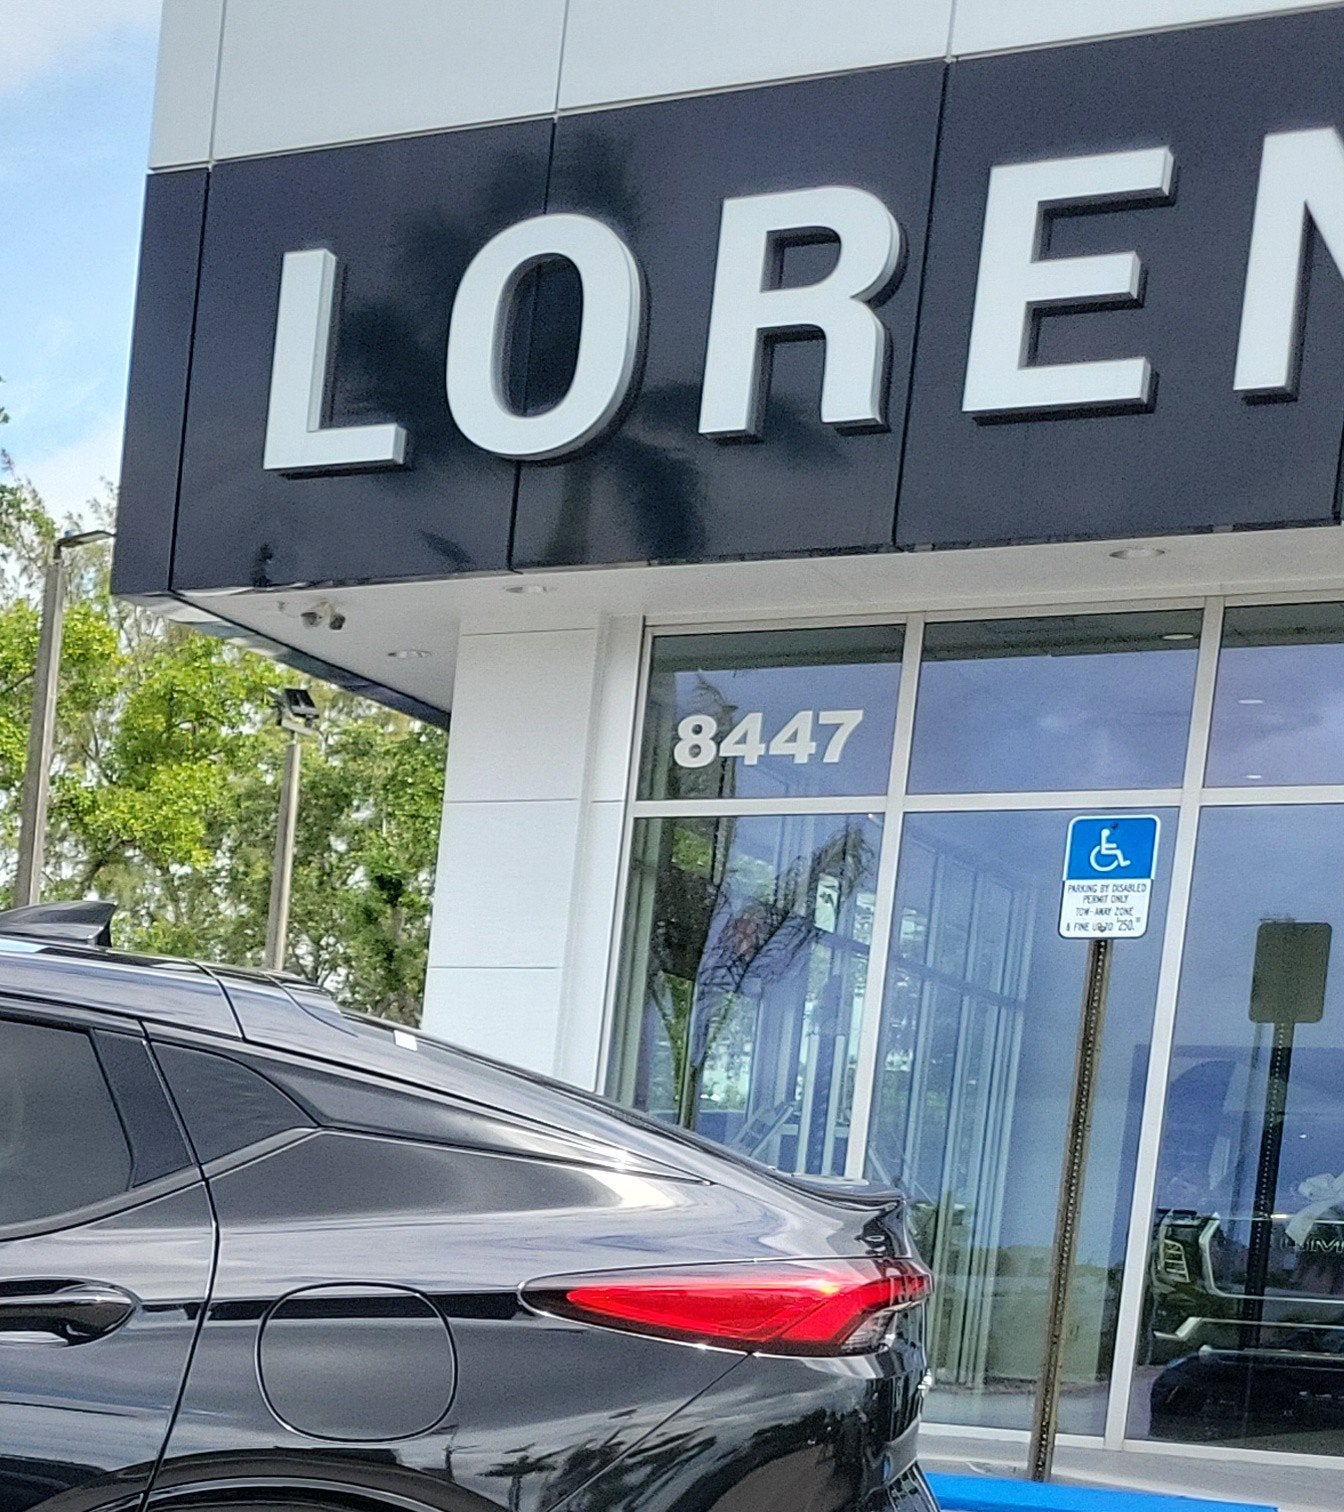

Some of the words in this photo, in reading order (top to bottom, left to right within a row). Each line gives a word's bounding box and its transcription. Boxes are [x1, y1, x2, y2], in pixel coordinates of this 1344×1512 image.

[673, 709, 863, 768] 8447
[1067, 884, 1098, 894] PARKING
[1100, 884, 1110, 893] BY
[1112, 883, 1147, 893] DISABLED
[1082, 895, 1109, 904] PERMIT
[1110, 895, 1130, 904] ONLY
[1114, 906, 1135, 917] ZONE
[1073, 922, 1090, 932] FINE
